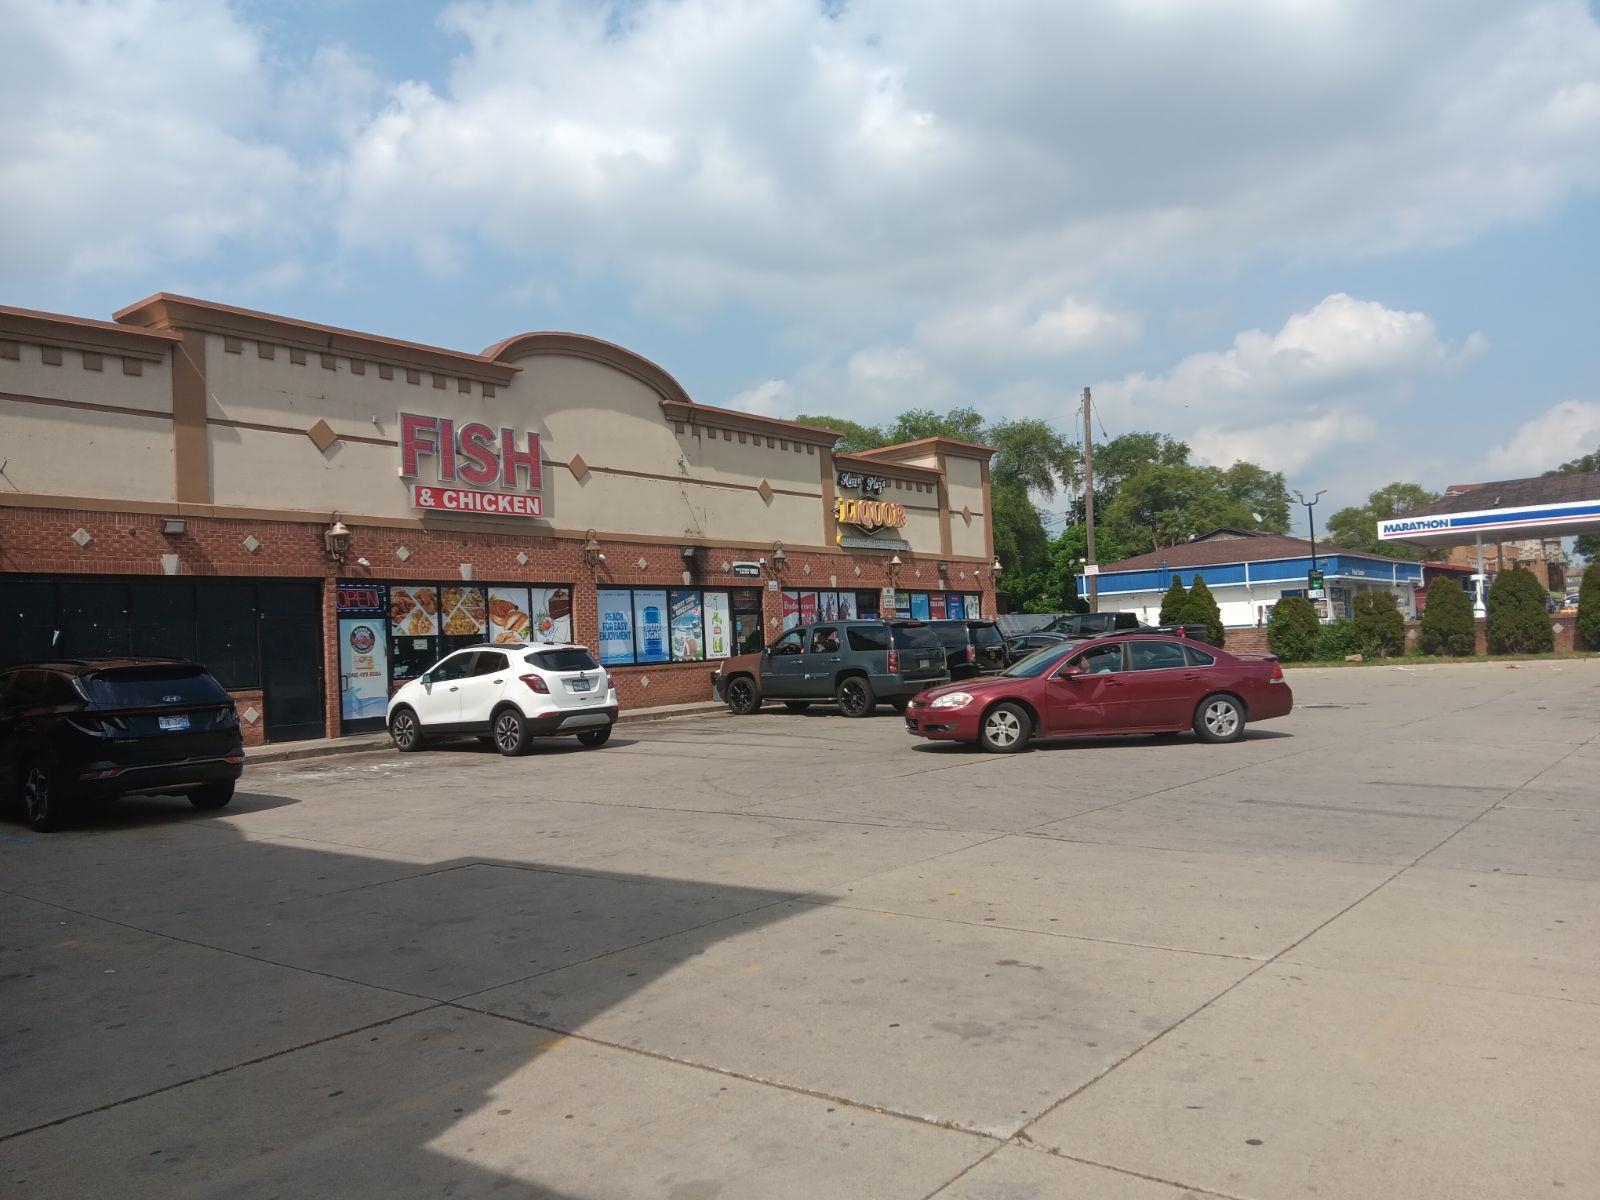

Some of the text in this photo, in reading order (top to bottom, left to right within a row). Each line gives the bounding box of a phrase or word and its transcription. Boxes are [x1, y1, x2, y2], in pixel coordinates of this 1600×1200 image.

[399, 412, 543, 491] FISH
[419, 488, 540, 514] & CHICKEN
[839, 498, 906, 529] LIQUOR
[1384, 519, 1449, 533] MARATHON
[337, 590, 379, 607] OPEN
[605, 612, 624, 621] REACH
[603, 622, 628, 631] FOR EASY
[599, 631, 632, 641] ENJOYMENT
